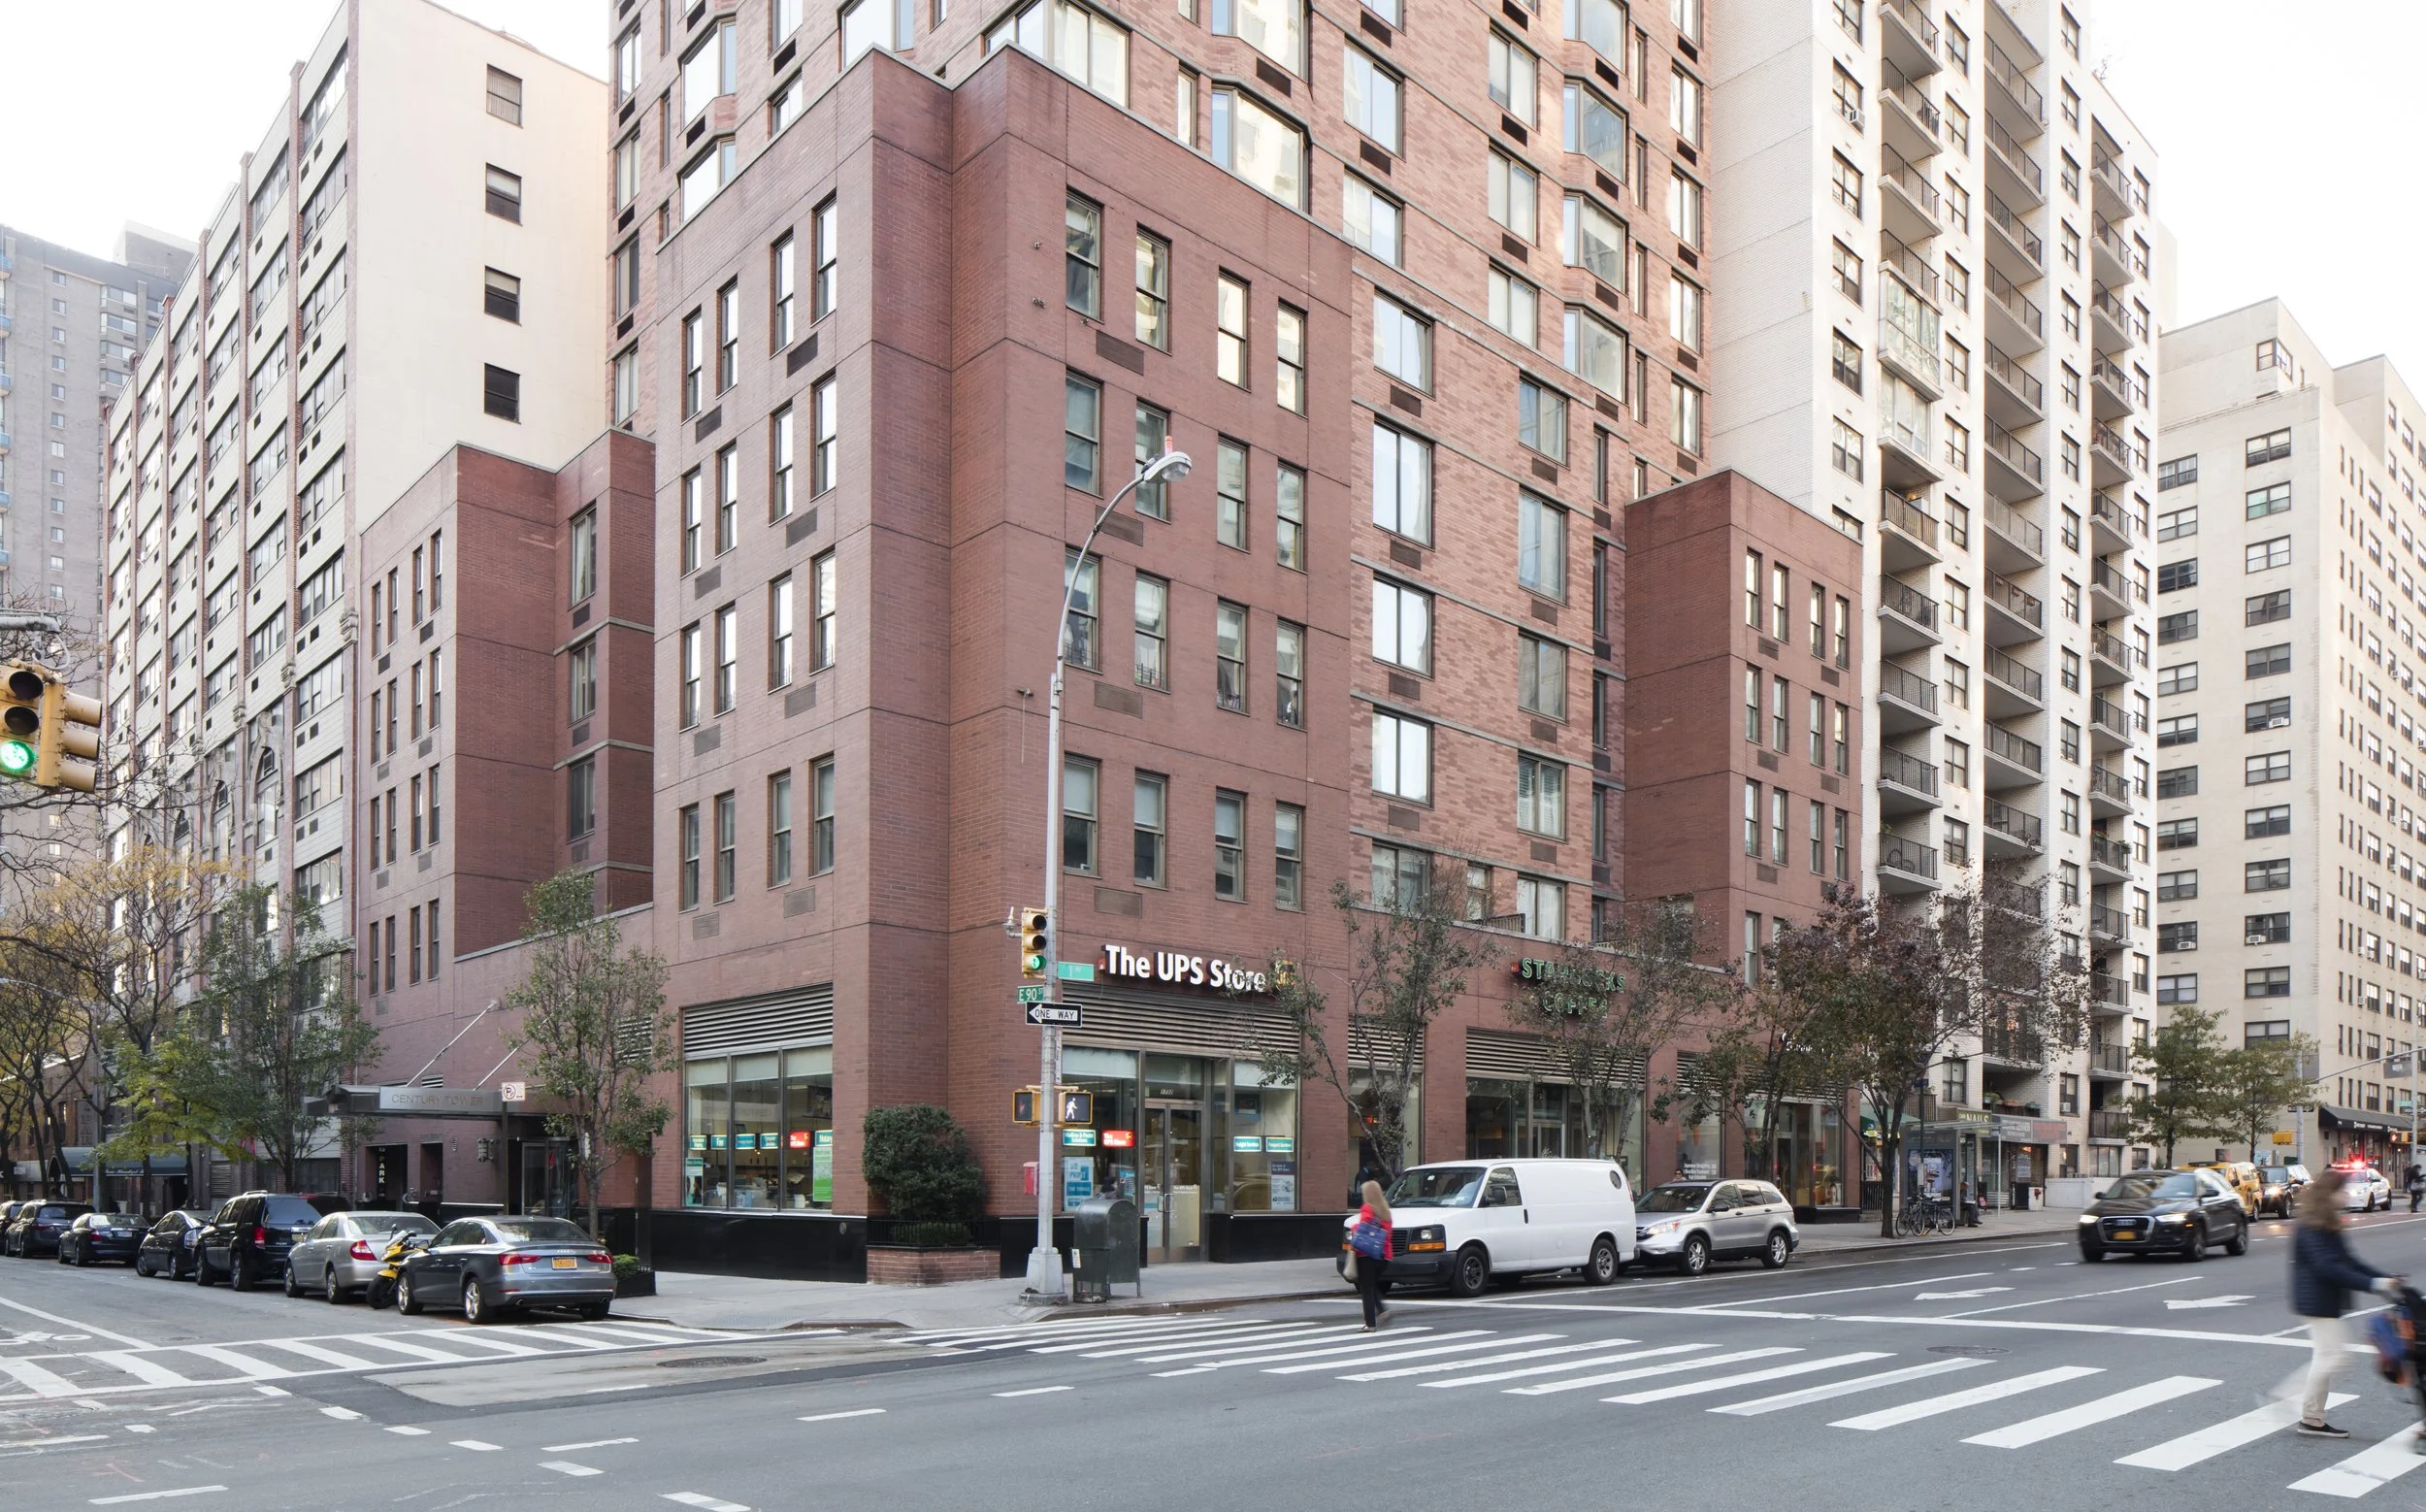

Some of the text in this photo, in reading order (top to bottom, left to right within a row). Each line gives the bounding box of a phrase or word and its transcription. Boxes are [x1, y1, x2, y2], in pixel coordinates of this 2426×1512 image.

[1105, 944, 1266, 993] The UPS Store
[1522, 957, 1626, 993] STAUKS
[1019, 989, 1025, 1002] E
[1026, 988, 1037, 1001] 90
[1034, 1009, 1074, 1020] ONE WAY
[391, 1094, 484, 1106] CENTURY TOWER
